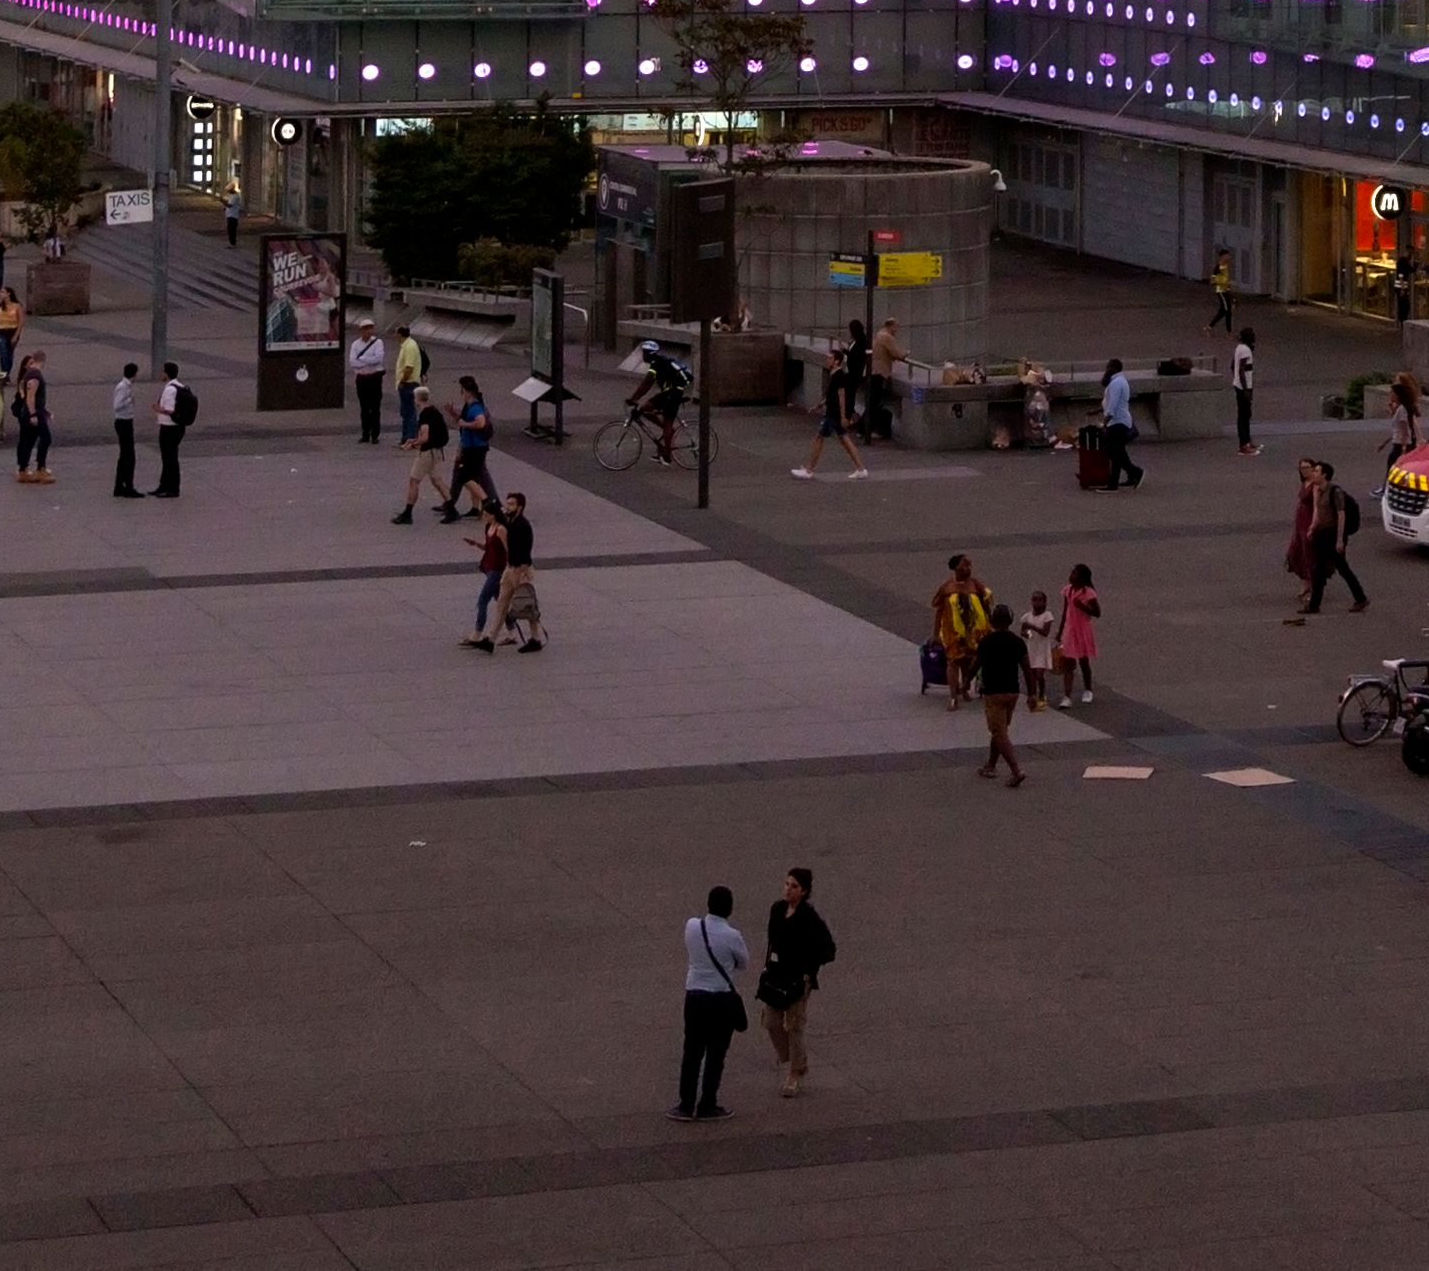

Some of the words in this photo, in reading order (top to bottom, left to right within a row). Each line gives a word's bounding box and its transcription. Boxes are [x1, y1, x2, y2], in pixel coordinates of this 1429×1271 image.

[109, 191, 151, 207] TAXIS
[272, 251, 298, 271] WE
[273, 262, 307, 287] RUN
